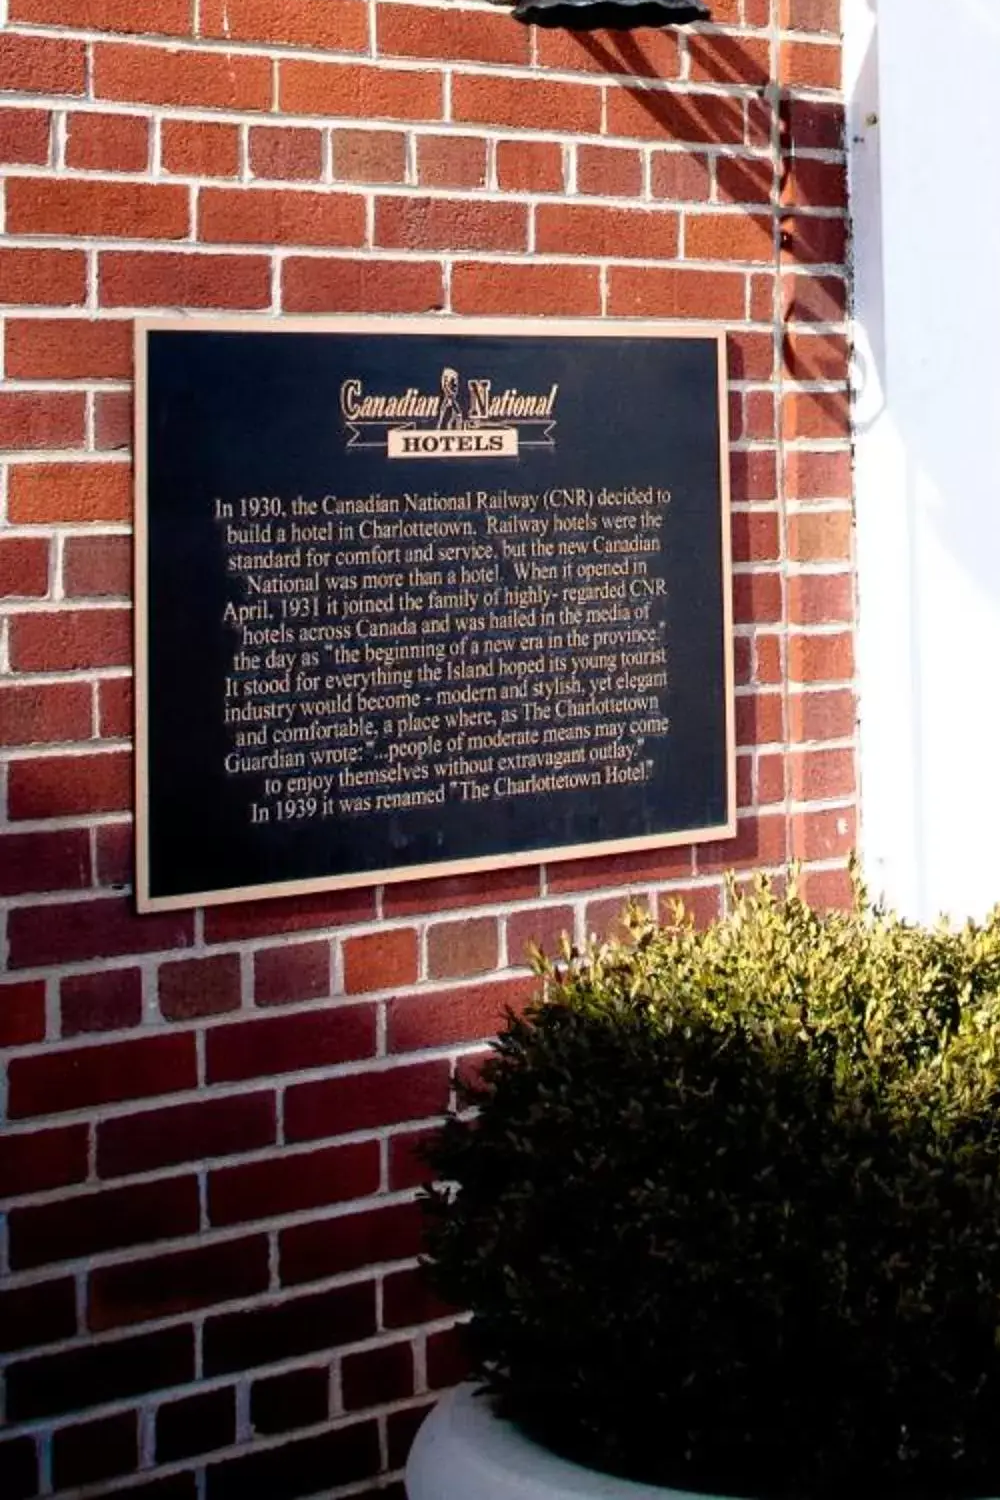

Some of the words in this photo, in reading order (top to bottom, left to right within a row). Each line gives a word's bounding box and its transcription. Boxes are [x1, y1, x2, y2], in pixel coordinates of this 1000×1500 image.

[340, 379, 440, 419] Canadian
[468, 379, 558, 418] National
[402, 436, 504, 452] HOTELS
[215, 498, 233, 518] In
[292, 495, 317, 516] the
[322, 492, 400, 514] Canadian
[403, 491, 471, 513] National
[477, 489, 539, 512] Railway
[543, 488, 593, 511] (CNR)
[598, 487, 653, 506] decided
[657, 487, 671, 504] to
[227, 523, 271, 545] build
[276, 529, 286, 542] a
[291, 521, 333, 542] hotel
[339, 521, 353, 540] in
[359, 518, 477, 540] Charlottetown.
[485, 513, 549, 536] Railway
[553, 512, 597, 532] hotels
[601, 515, 636, 529] were
[641, 510, 663, 528] the
[228, 548, 300, 571] standard
[305, 546, 330, 568] for
[336, 545, 401, 565] comfort
[405, 543, 433, 561] and
[502, 540, 527, 557] but
[531, 538, 553, 556] the
[559, 541, 589, 555] new
[593, 535, 661, 553] Canadian
[247, 572, 320, 595] National
[325, 576, 357, 591] was
[362, 573, 403, 589] more
[409, 568, 443, 587] than
[447, 571, 456, 584] a
[514, 561, 557, 580] When
[563, 561, 574, 579] it
[576, 559, 629, 578] opened
[633, 558, 647, 574] in
[282, 597, 319, 618] 1931
[326, 596, 338, 616] it
[341, 593, 394, 620] joined
[399, 592, 423, 611] the
[428, 589, 478, 611] family
[484, 588, 500, 606] of
[629, 579, 668, 596] CNR
[242, 624, 295, 645] hotels
[299, 625, 351, 641] across
[356, 617, 417, 637] Canada
[421, 613, 449, 632] and
[455, 616, 485, 631] was
[489, 609, 536, 629] hailed
[541, 609, 555, 626] in
[560, 607, 582, 624] the
[586, 604, 631, 622] media
[634, 602, 649, 619] of
[225, 676, 238, 697] It
[243, 674, 290, 695] stood
[296, 673, 320, 692] for
[325, 668, 412, 692] everything
[417, 665, 442, 681] the
[447, 659, 494, 681] Island
[500, 656, 545, 679] hoped
[549, 654, 566, 671] its
[571, 654, 617, 673] young
[620, 647, 667, 666] tourist
[233, 652, 261, 671] the
[265, 649, 296, 672] day
[301, 651, 320, 667] as
[325, 645, 362, 664] "the
[365, 641, 446, 665] beginning
[450, 636, 467, 655] of
[471, 640, 479, 654] a
[483, 638, 514, 653] new
[520, 636, 543, 650] era
[548, 633, 563, 649] in
[567, 630, 589, 647] the
[225, 700, 297, 724] industry
[300, 695, 351, 716] would
[357, 692, 421, 711] become
[437, 684, 497, 705] modern
[500, 679, 527, 699] and
[589, 676, 612, 695] yet
[615, 671, 667, 692] elegant
[236, 725, 267, 747] and
[272, 717, 379, 743] comfortable,
[384, 720, 393, 733] a
[397, 713, 440, 737] place
[445, 709, 497, 728] where,
[501, 709, 517, 723] as
[522, 703, 551, 721] The
[555, 694, 659, 717] Charlottetown
[224, 748, 305, 774] Guardian
[448, 731, 466, 751] of
[468, 729, 538, 751] moderate
[543, 727, 591, 742] means
[595, 722, 625, 740] may
[630, 717, 669, 734] come
[265, 778, 281, 796] to
[287, 772, 334, 795] enjoy
[339, 763, 429, 787] themselves
[434, 756, 494, 777] without
[500, 749, 586, 771] extravagant
[251, 803, 269, 823] In
[277, 797, 317, 820] 1939
[323, 796, 334, 815] it
[339, 797, 371, 813] was
[375, 785, 445, 809] renamed
[450, 781, 490, 800] "The
[494, 771, 601, 796] Charlottetown
